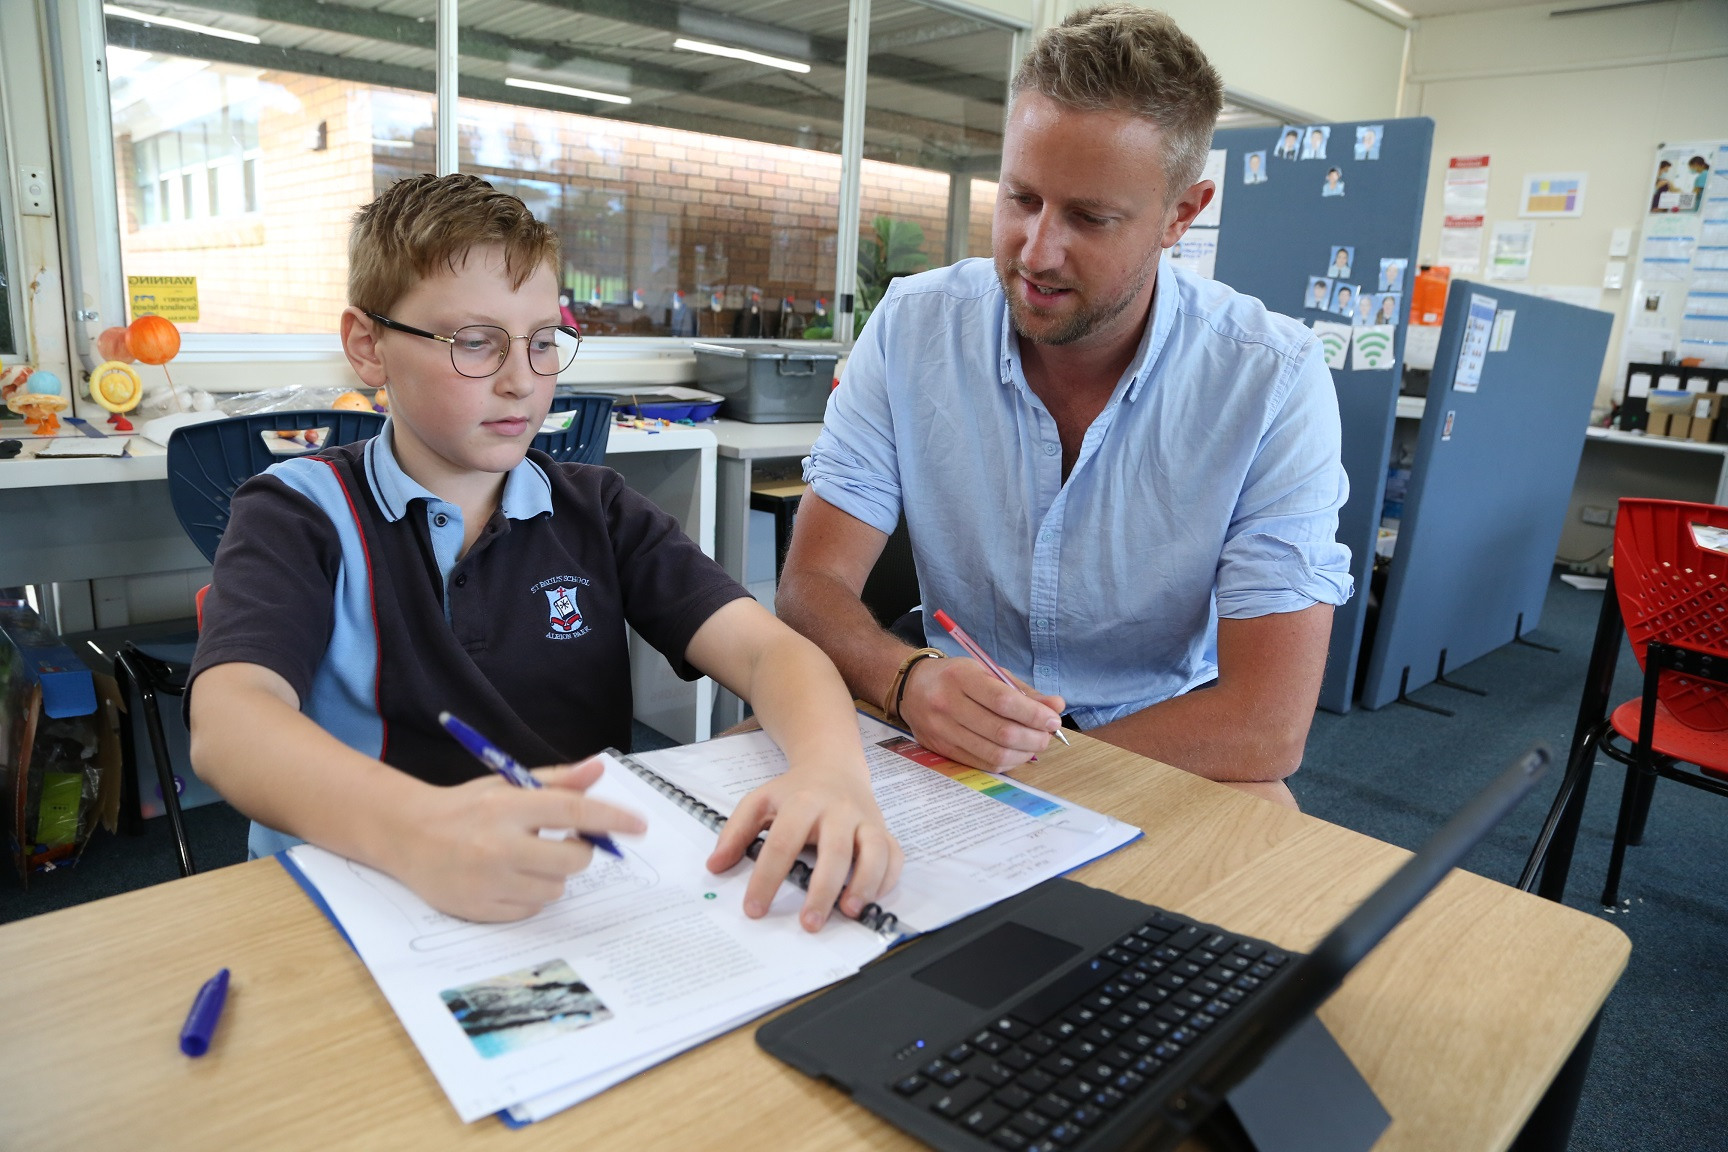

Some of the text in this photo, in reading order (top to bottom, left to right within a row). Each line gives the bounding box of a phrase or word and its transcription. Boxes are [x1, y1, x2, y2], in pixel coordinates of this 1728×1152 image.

[530, 584, 540, 594] ST
[563, 576, 590, 586] SCHOOL
[546, 626, 592, 640] ALBION PARK
